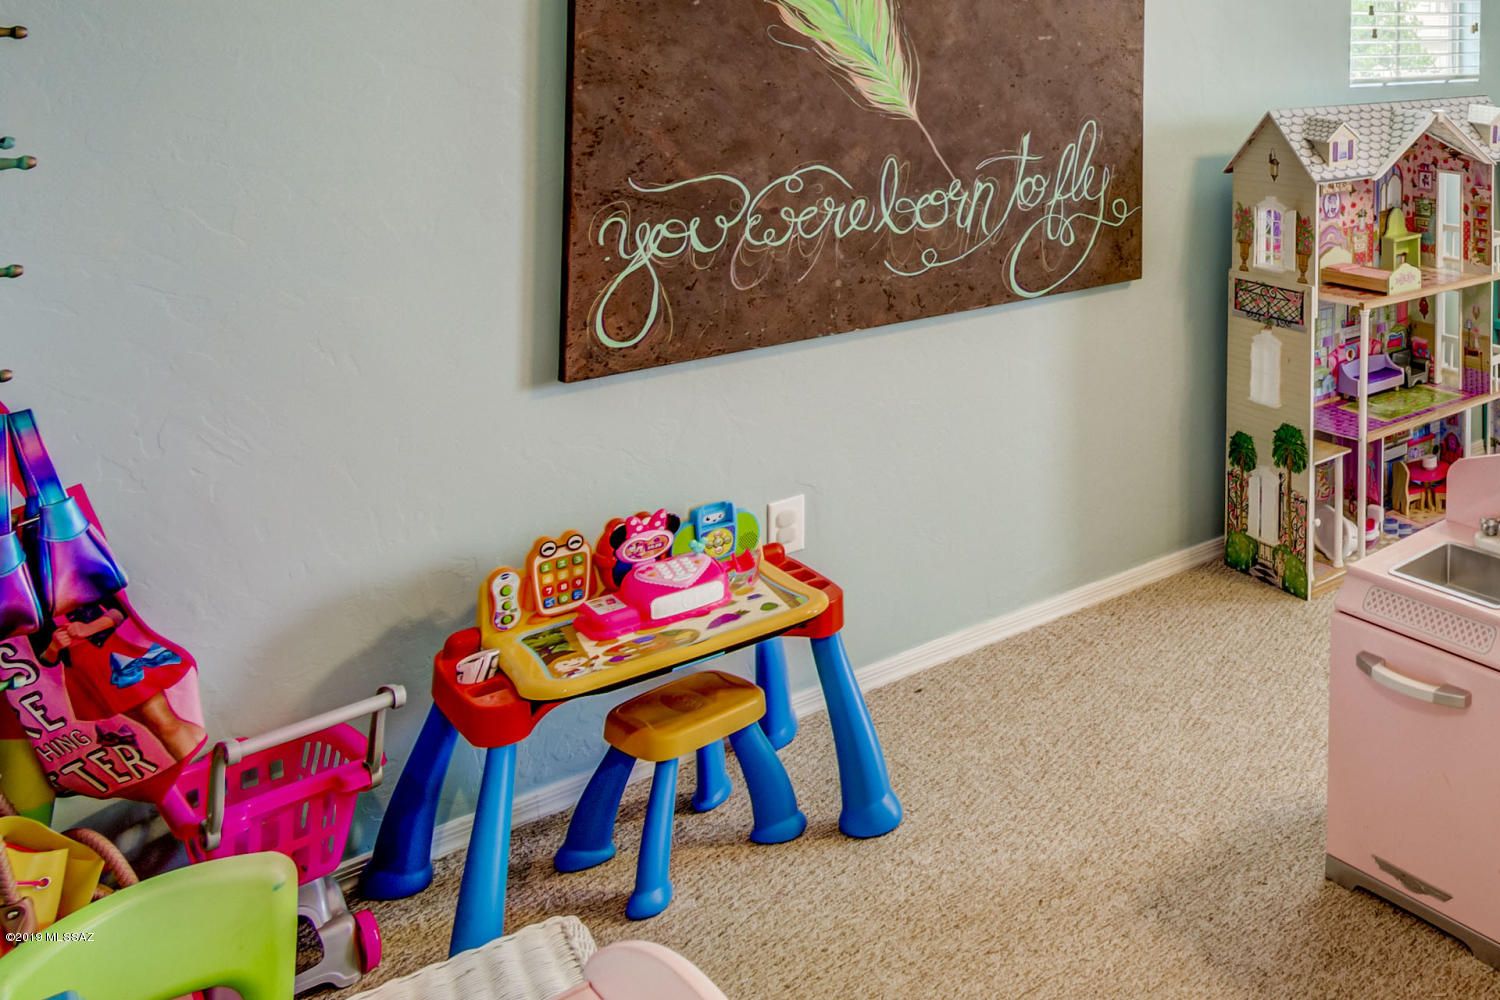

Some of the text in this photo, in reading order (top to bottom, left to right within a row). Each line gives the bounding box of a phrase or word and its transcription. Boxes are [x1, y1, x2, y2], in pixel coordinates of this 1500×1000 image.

[594, 172, 750, 349] you
[878, 153, 998, 238] born
[1010, 118, 1142, 299] fly
